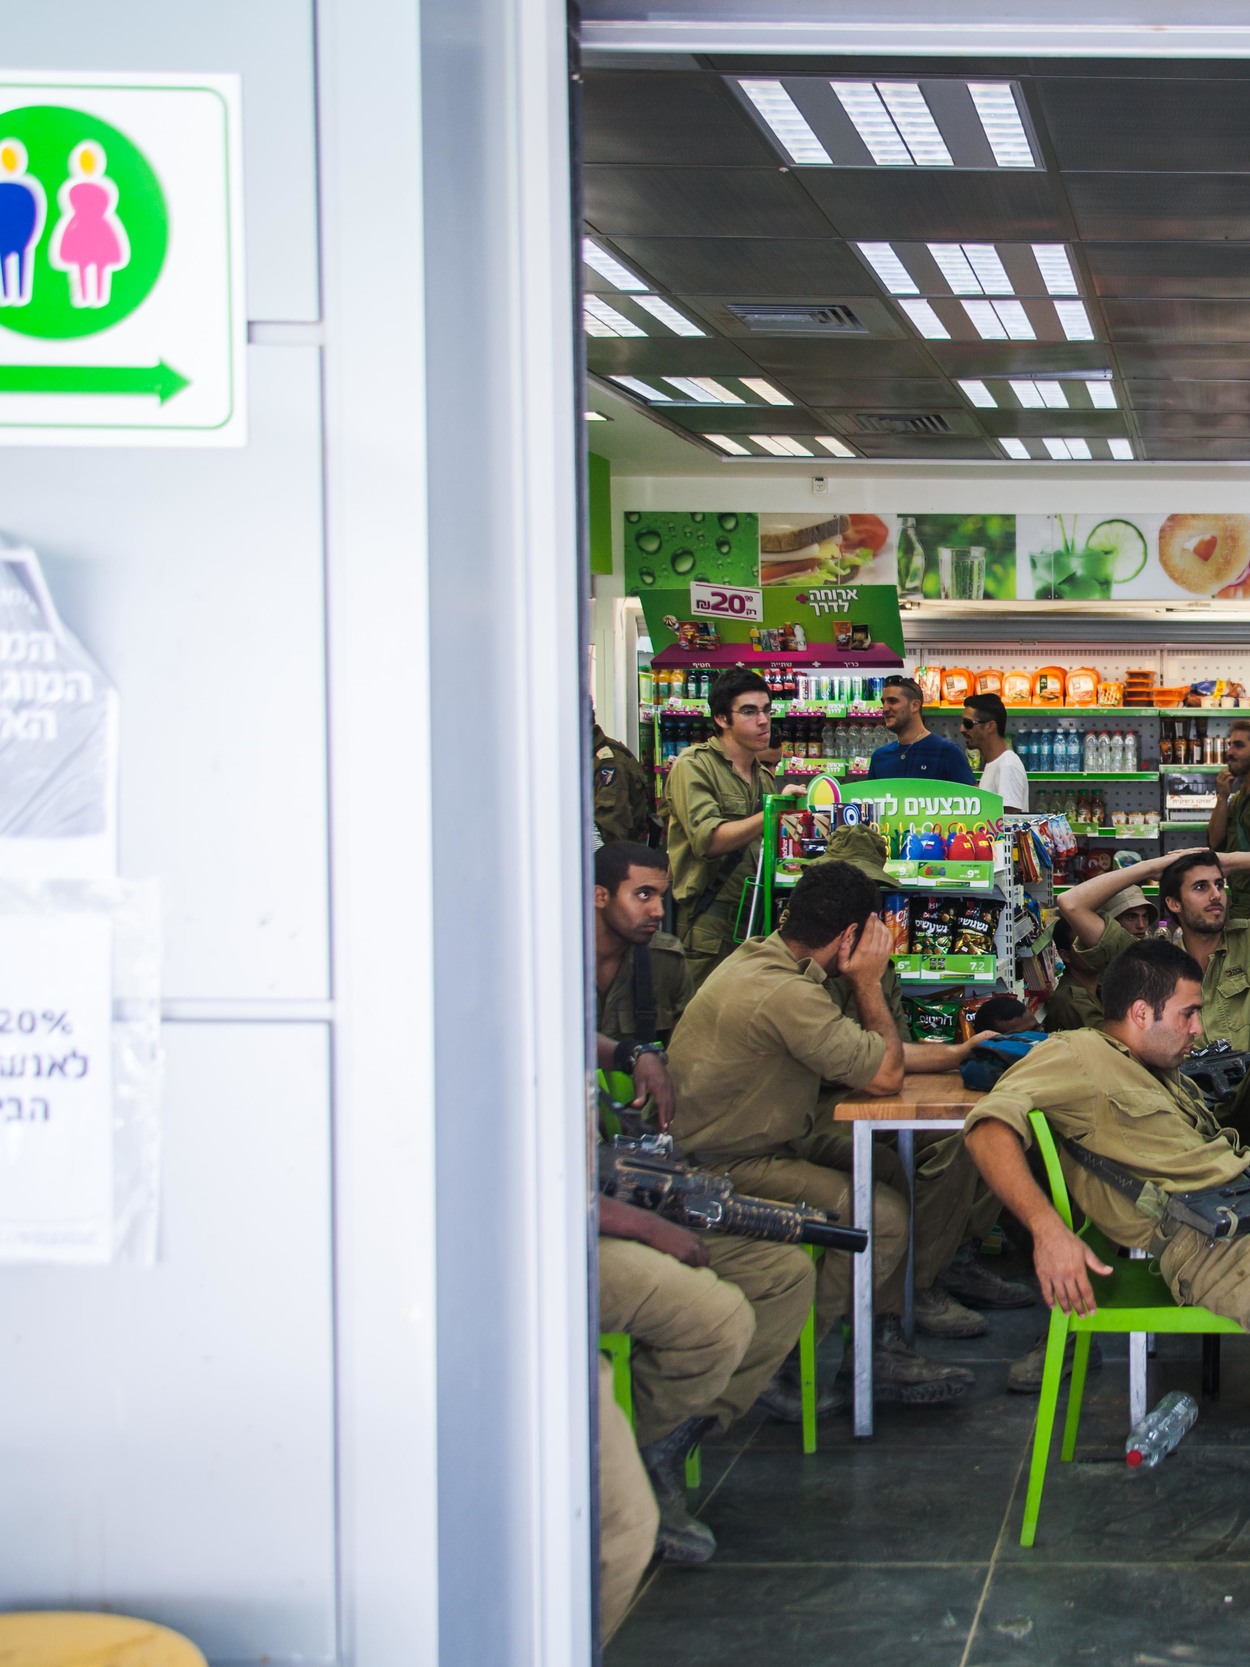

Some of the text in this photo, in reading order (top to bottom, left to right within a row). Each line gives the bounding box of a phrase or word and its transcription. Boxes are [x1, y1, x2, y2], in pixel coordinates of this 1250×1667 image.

[808, 589, 858, 601] ארוחה
[810, 600, 850, 616] לדרך
[904, 796, 981, 816] מבצעים
